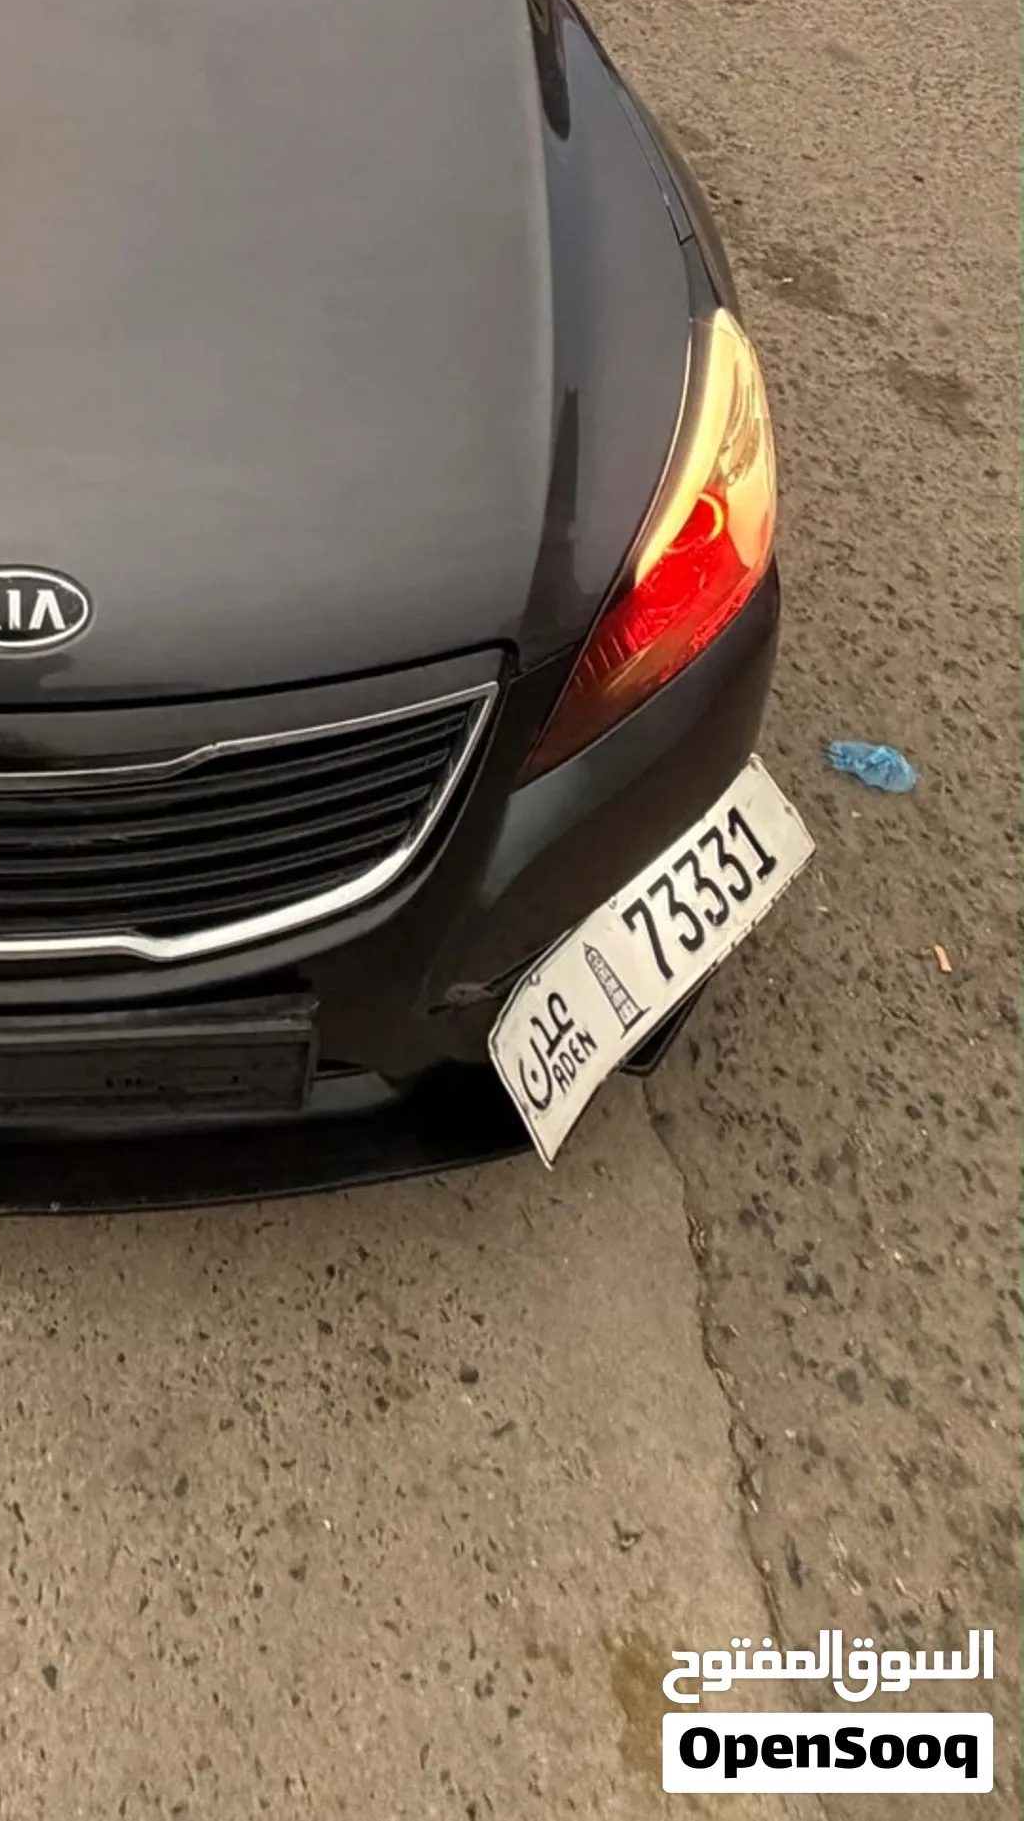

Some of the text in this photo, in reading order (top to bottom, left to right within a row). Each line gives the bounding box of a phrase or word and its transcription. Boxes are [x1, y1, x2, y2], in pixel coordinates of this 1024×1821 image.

[621, 806, 777, 981] 73331
[519, 992, 575, 1112] عدن
[555, 1030, 599, 1100] ADEN
